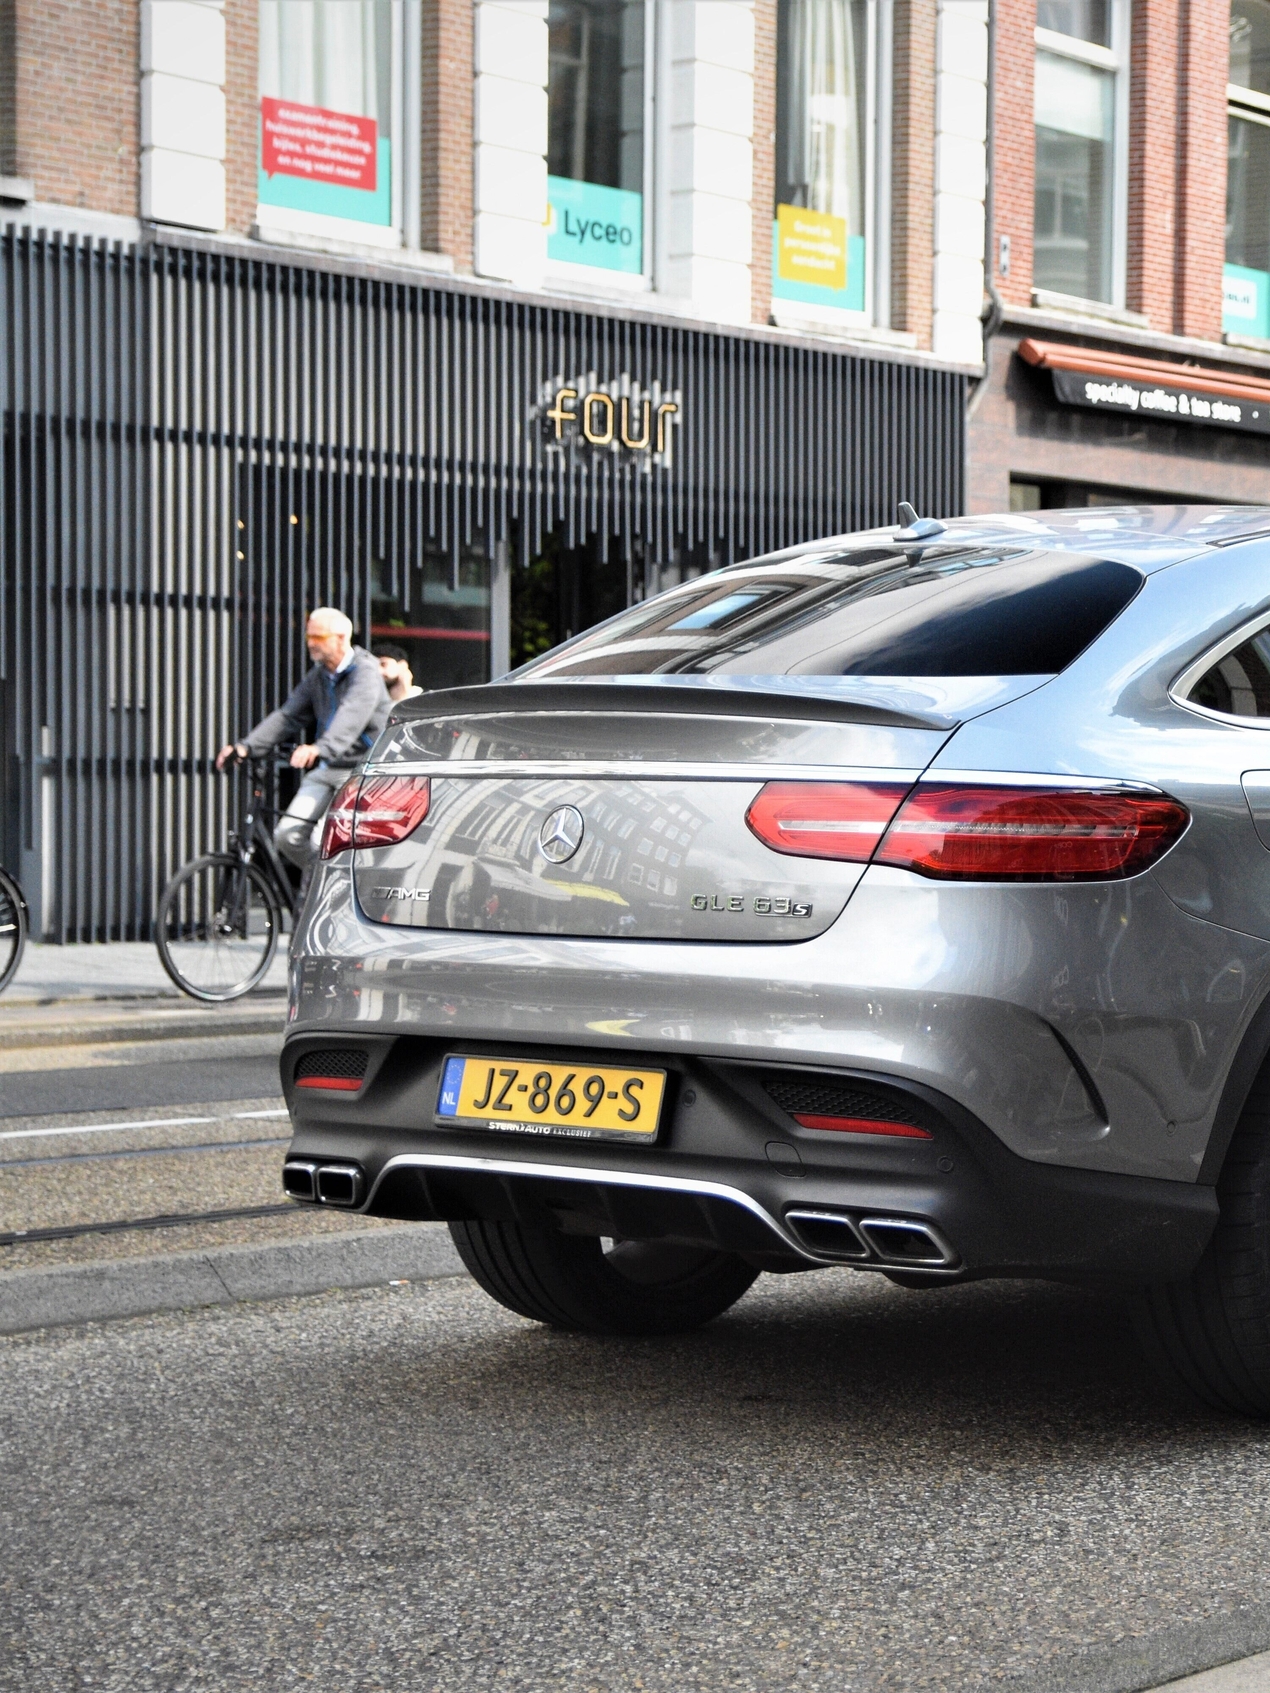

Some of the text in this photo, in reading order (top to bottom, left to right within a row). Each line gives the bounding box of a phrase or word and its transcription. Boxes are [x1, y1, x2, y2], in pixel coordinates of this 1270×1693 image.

[564, 208, 633, 246] Lyceo
[1085, 382, 1242, 422] specialty coffee & tea store
[547, 388, 678, 453] four
[388, 887, 431, 901] AMG
[690, 894, 744, 912] GLE
[442, 1091, 456, 1106] NL
[473, 1067, 644, 1122] JZ-869-S
[524, 1125, 551, 1135] AUTO
[553, 1127, 592, 1138] EXCLUSIEF
